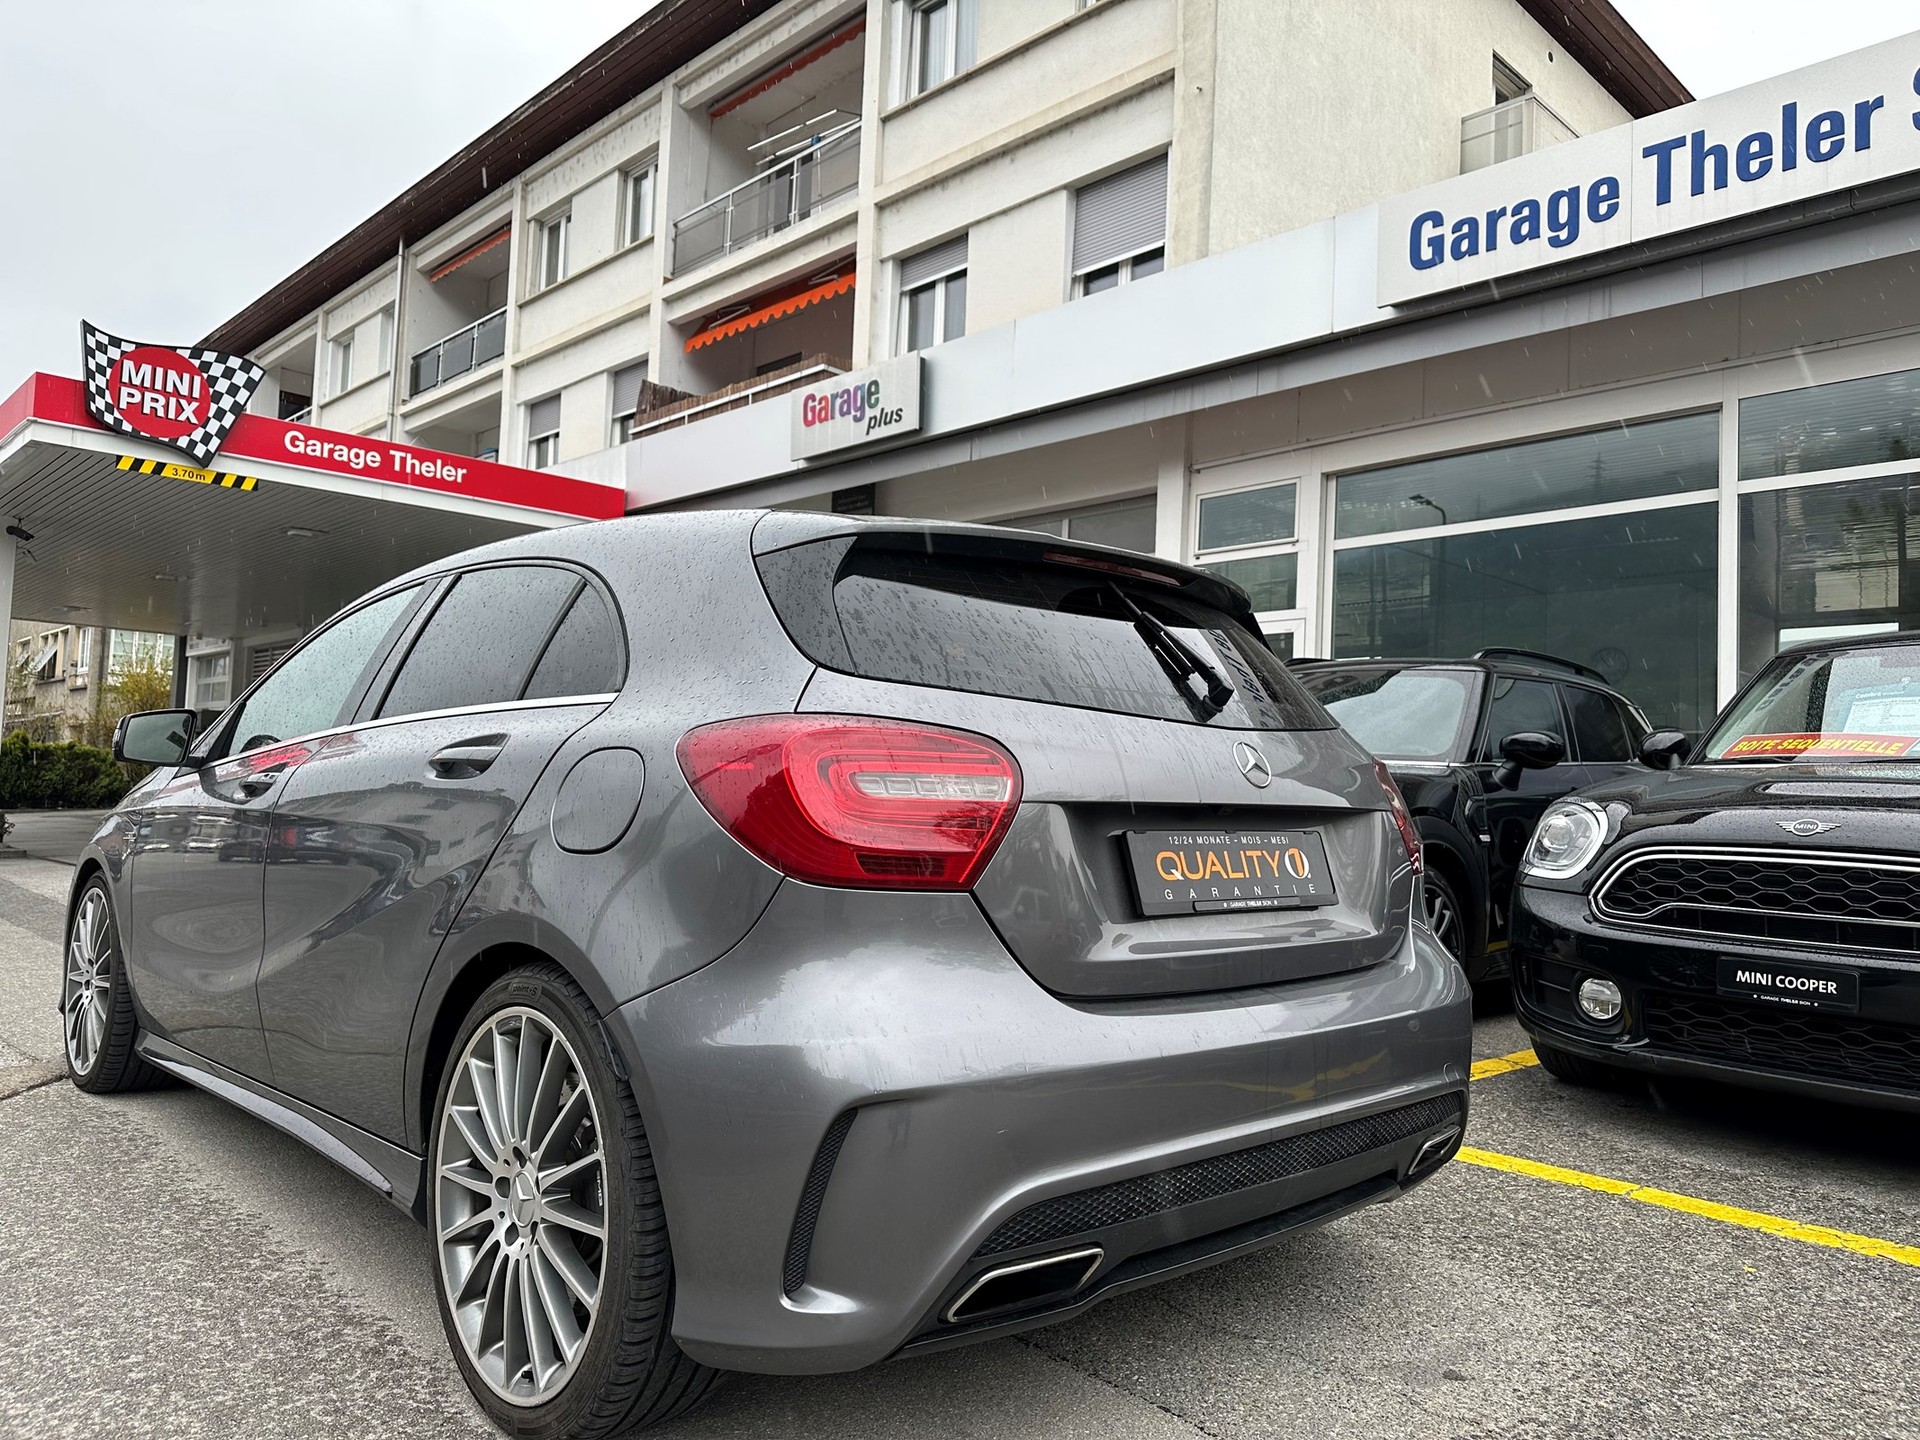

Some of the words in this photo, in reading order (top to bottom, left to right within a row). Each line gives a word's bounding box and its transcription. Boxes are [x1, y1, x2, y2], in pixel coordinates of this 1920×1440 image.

[1409, 175, 1621, 271] Garage
[1641, 95, 1885, 206] Theler
[120, 358, 201, 399] MINI
[119, 386, 200, 425] PRIX
[803, 379, 880, 427] Garage
[865, 407, 904, 436] plus
[284, 430, 382, 469] Garage
[389, 450, 467, 483] Theler
[1735, 739, 1780, 752] BOITE
[1777, 738, 1906, 755] SEQUENTIELLE
[1168, 836, 1193, 845] 12/24
[1196, 836, 1231, 845] MONATE
[1241, 836, 1261, 845] MOIS
[1270, 836, 1289, 845] MESI
[1155, 850, 1280, 881] QUALITY
[1164, 884, 1316, 900] GARANTIE
[1736, 970, 1772, 986] MINI
[1775, 975, 1838, 994] COOPER
